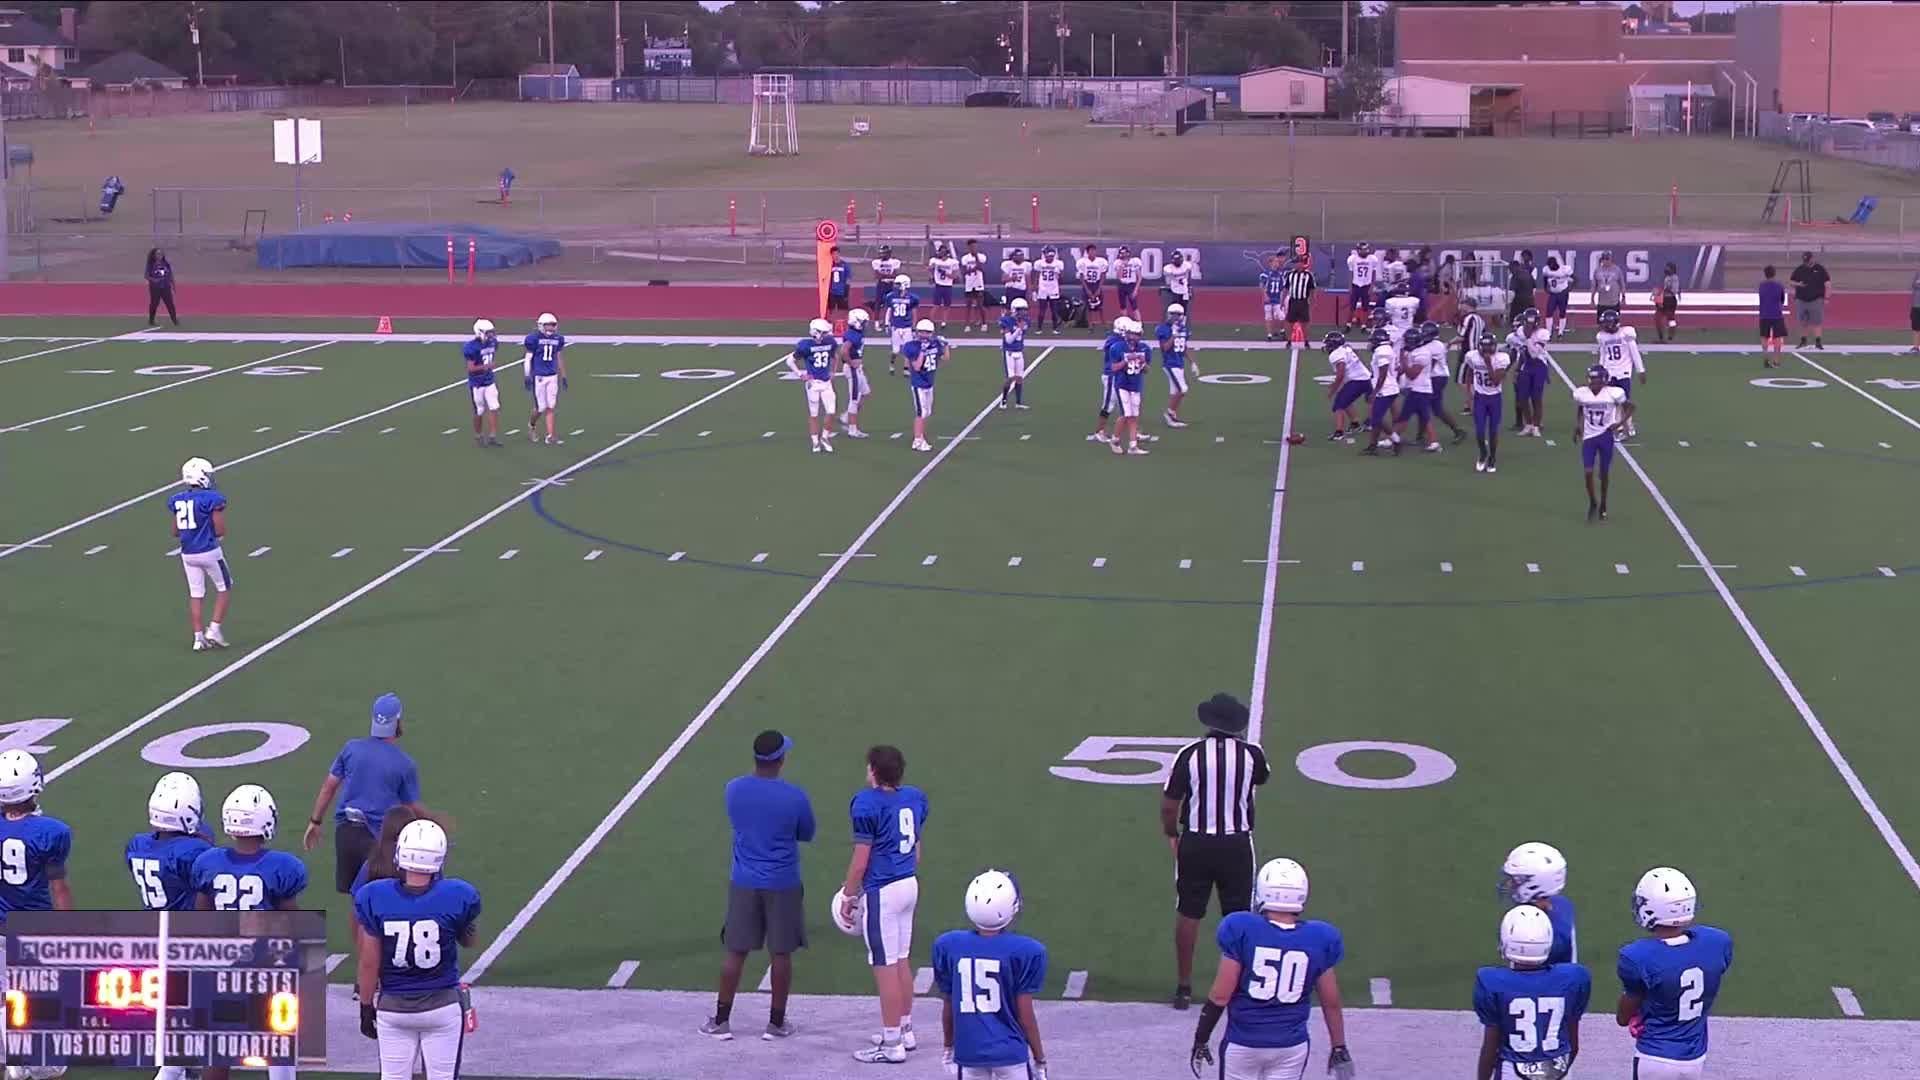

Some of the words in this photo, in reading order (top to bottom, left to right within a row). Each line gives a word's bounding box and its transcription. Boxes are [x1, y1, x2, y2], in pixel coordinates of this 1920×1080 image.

[1358, 266, 1369, 278] 57
[542, 345, 553, 361] 11
[813, 351, 829, 368] 33
[924, 354, 937, 371] 45
[1606, 345, 1621, 361] 18
[175, 500, 198, 530] 21
[899, 808, 915, 854] 9
[0, 838, 28, 885] 9
[131, 858, 169, 908] 55
[213, 873, 265, 910] 22
[384, 919, 442, 970] 78
[958, 957, 1002, 1014] 15
[1248, 948, 1309, 1004] 50
[1678, 966, 1705, 1021] 2
[1508, 996, 1566, 1052] 37
